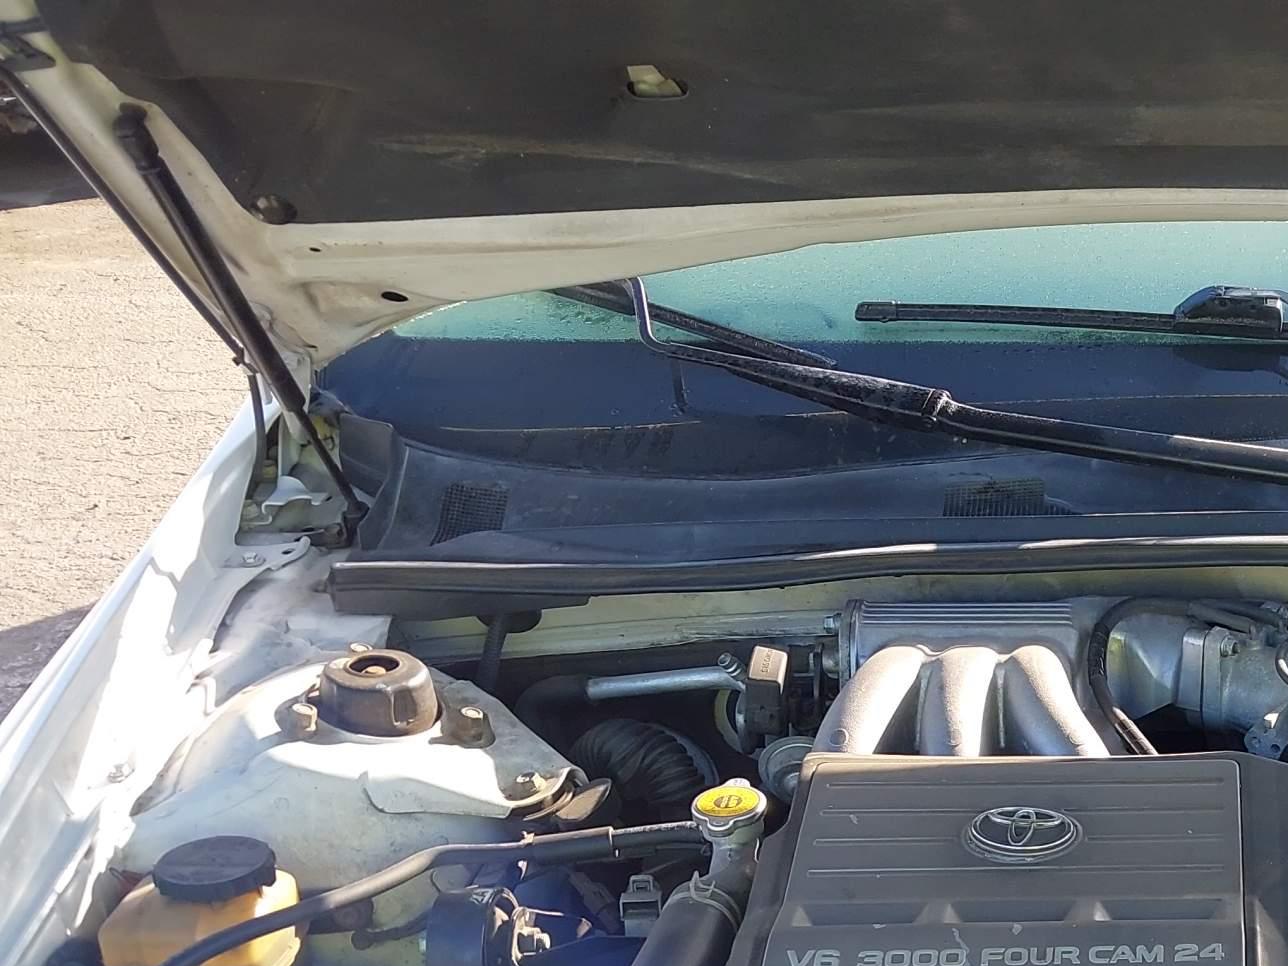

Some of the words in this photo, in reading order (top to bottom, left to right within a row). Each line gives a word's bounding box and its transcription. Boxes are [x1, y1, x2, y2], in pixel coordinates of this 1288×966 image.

[980, 946, 1081, 966] FOUR
[1088, 944, 1164, 965] CAM
[1174, 943, 1225, 963] 24
